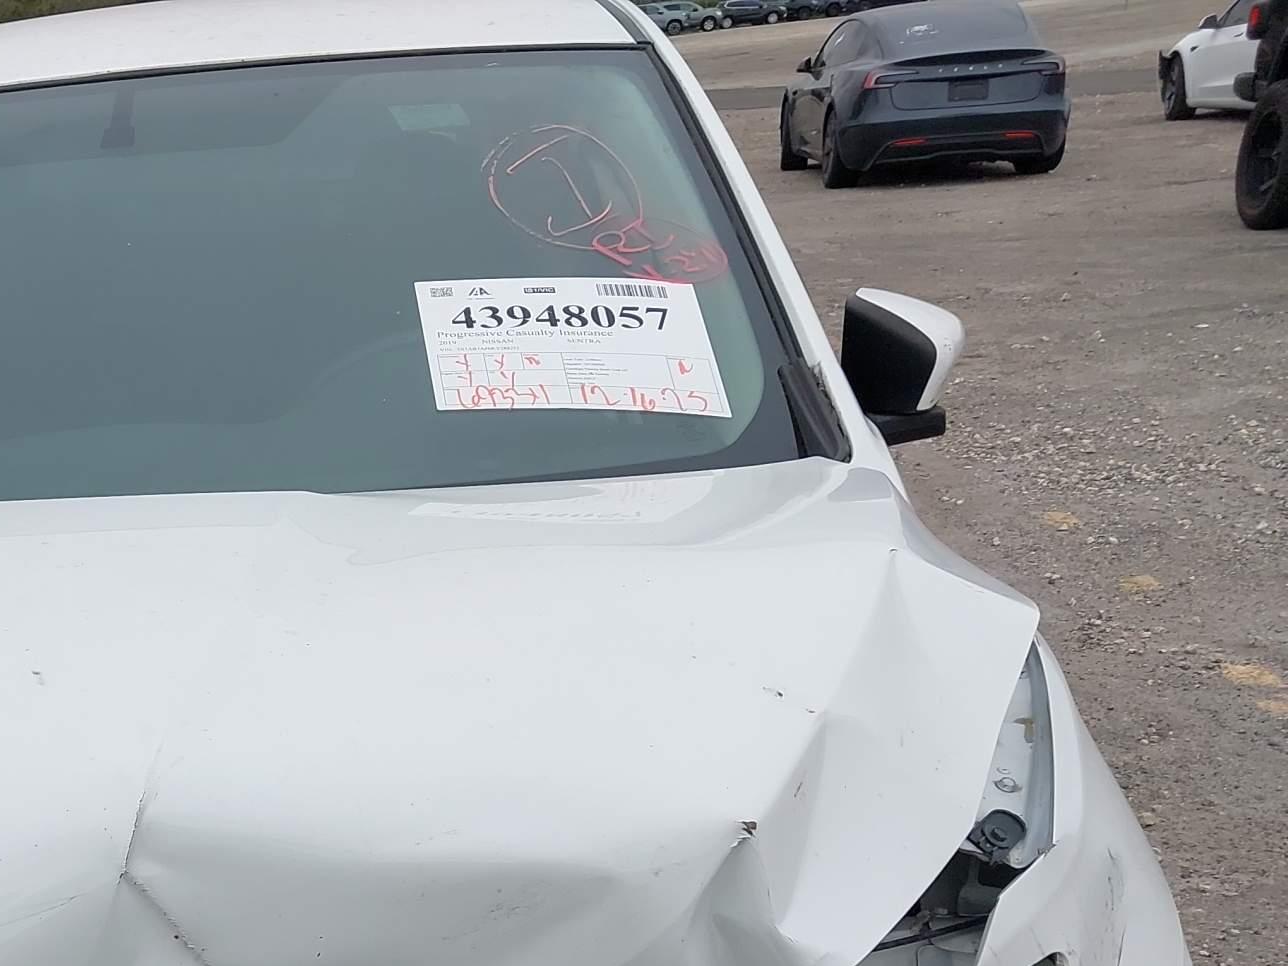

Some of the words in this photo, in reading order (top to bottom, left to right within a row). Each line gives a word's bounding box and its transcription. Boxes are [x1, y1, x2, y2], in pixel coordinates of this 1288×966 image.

[451, 304, 669, 331] 43948057
[437, 331, 501, 339] Progressive
[506, 329, 555, 338] Casualty
[560, 329, 614, 337] Insurance
